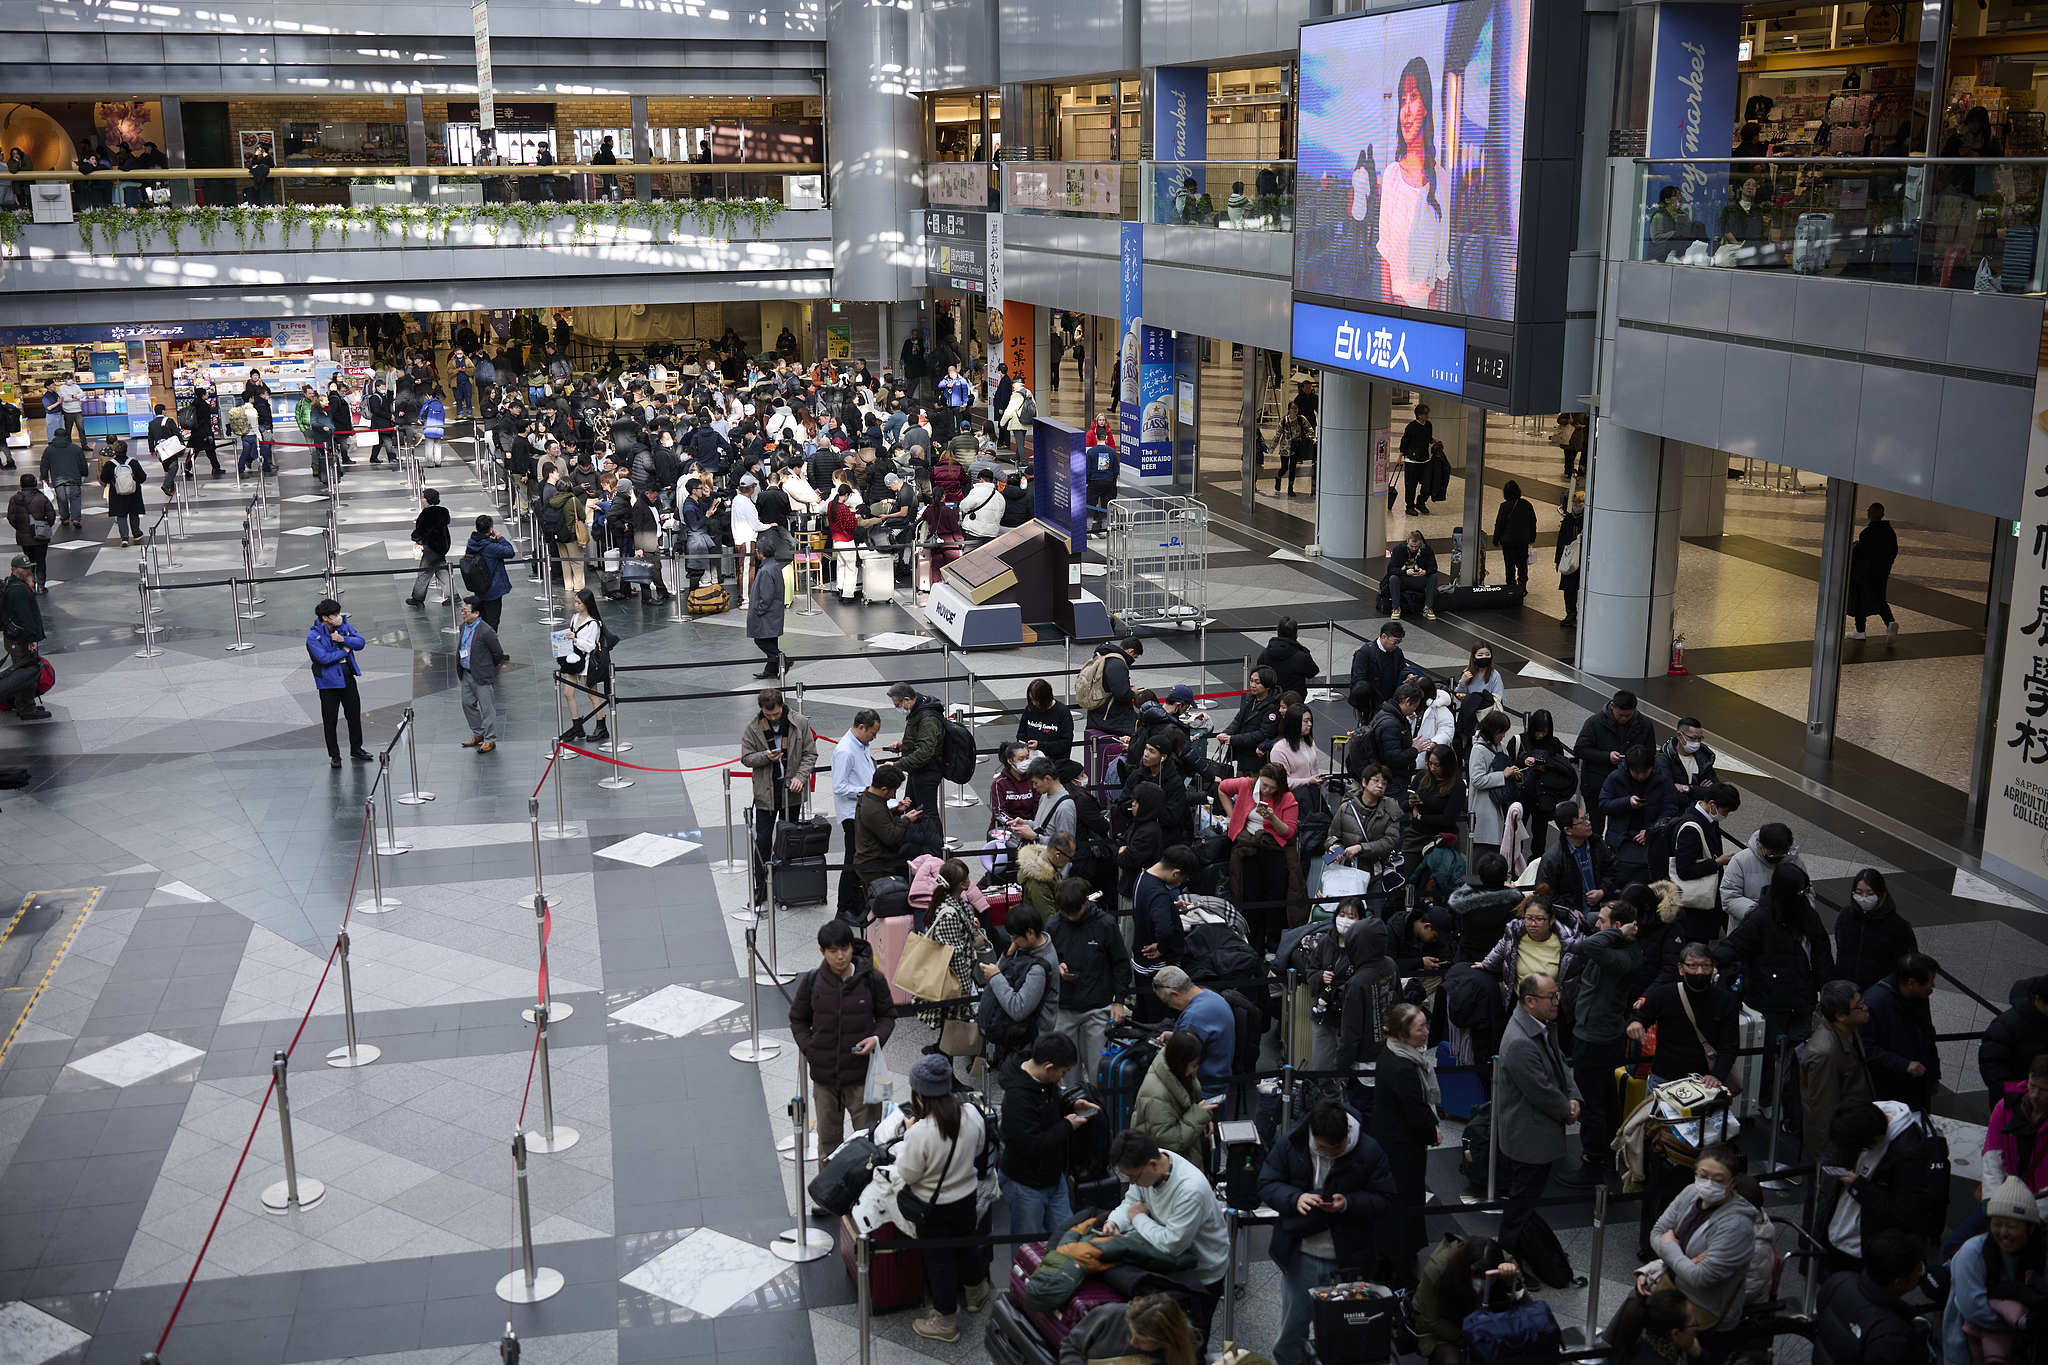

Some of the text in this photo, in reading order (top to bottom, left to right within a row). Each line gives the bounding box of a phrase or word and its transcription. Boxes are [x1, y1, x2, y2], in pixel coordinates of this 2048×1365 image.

[1334, 320, 1410, 373] 白い恋人
[1476, 357, 1504, 379] 11:13
